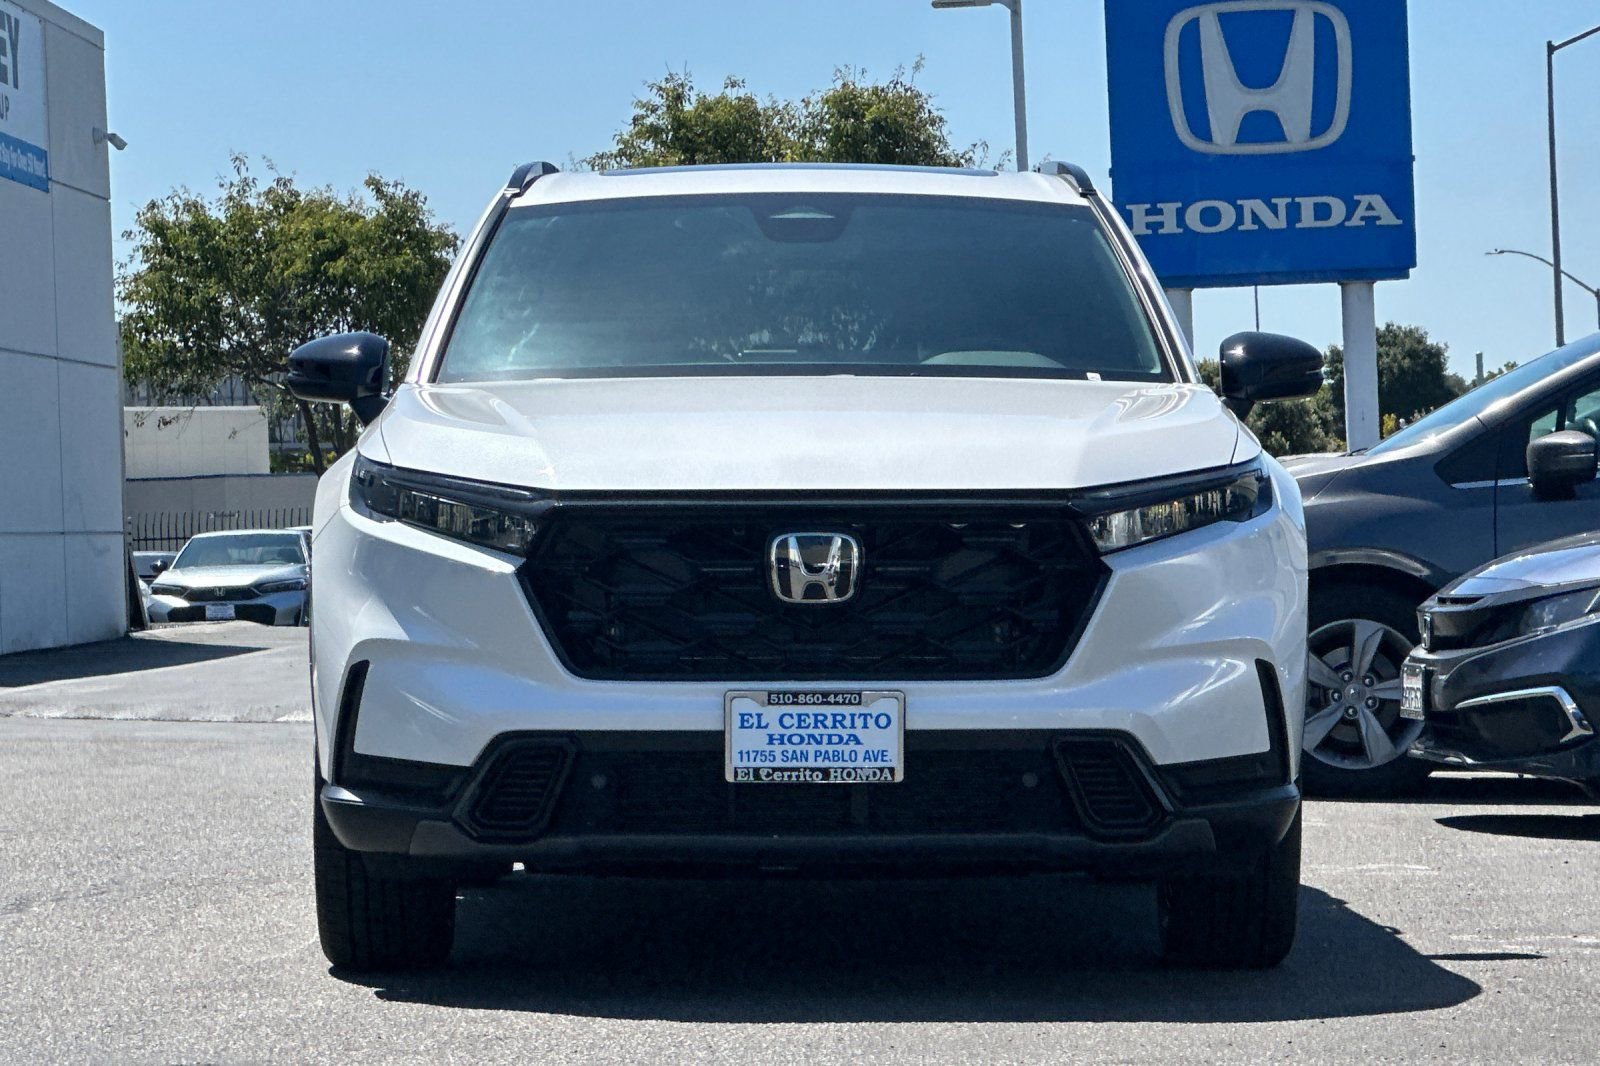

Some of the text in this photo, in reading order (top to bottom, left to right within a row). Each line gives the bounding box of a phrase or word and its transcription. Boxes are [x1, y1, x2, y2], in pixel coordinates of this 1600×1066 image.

[1125, 194, 1403, 236] HONDA
[769, 693, 860, 705] 510-860-4470
[738, 712, 892, 730] EL CERRITO
[766, 733, 864, 746] HONDA
[737, 749, 893, 763] 11755 SAN PABLO AVE.
[736, 767, 893, 781] El Cerrito HONDA
